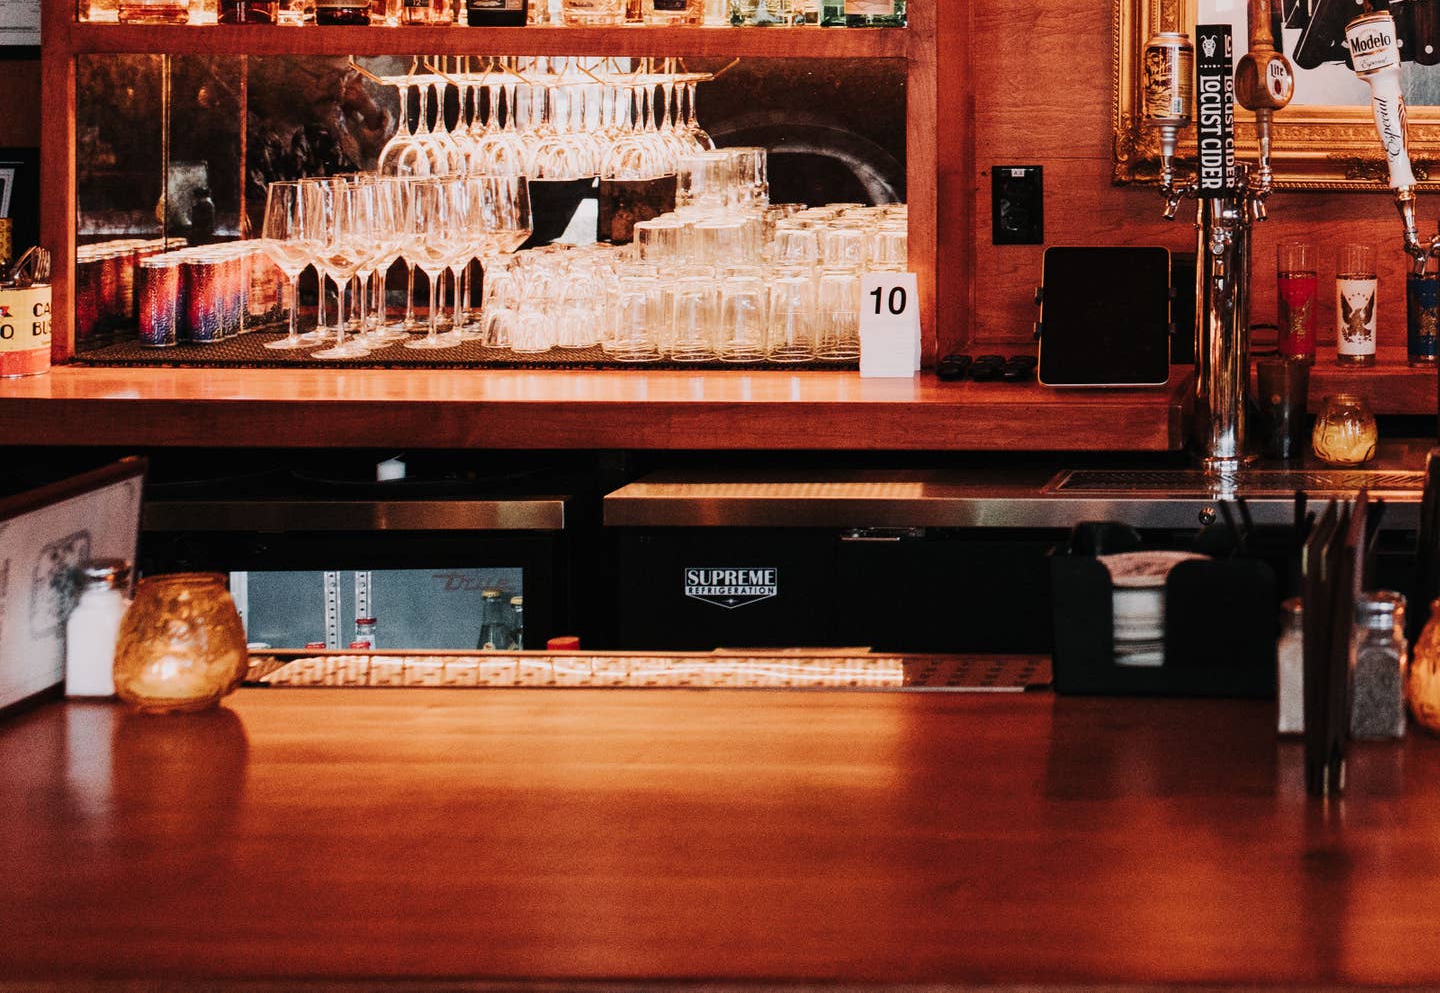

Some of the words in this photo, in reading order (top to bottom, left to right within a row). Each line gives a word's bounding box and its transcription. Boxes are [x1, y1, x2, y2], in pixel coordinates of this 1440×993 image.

[1350, 32, 1392, 54] Modelo
[1270, 63, 1284, 78] Lite
[1200, 74, 1222, 136] LOCUST
[1224, 75, 1234, 135] LOCUST
[1201, 138, 1223, 189] CIDER
[1225, 138, 1235, 188] CIDER
[33, 302, 52, 317] CA
[869, 285, 907, 316] 10
[687, 569, 775, 586] SUPREME
[688, 586, 774, 594] REFRIGERATION
